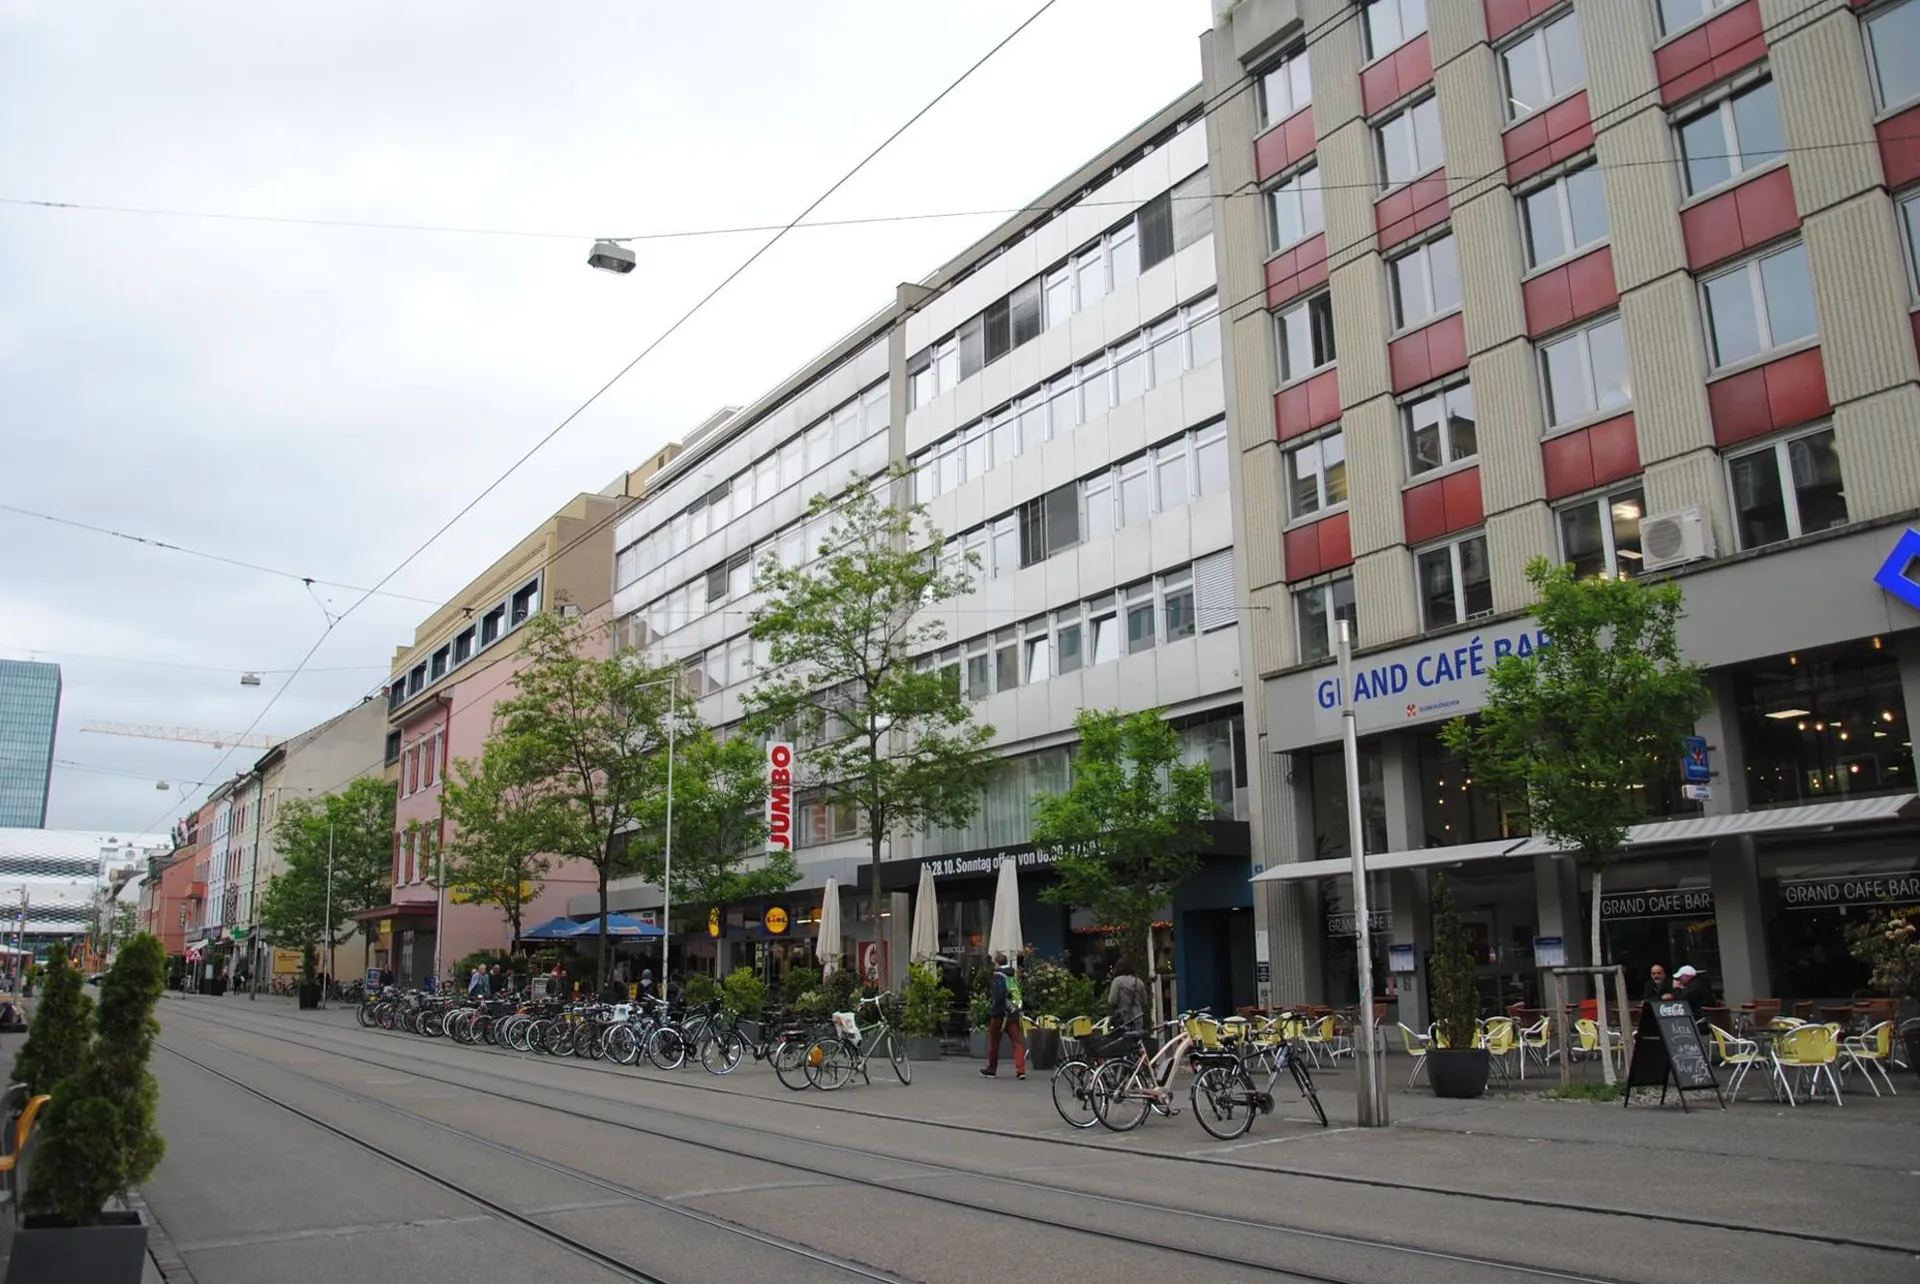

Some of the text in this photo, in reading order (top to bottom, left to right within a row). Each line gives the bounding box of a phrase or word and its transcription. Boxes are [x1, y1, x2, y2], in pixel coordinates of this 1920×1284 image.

[1416, 635, 1486, 687] CAFÉ
[771, 745, 791, 850] JUMBO
[931, 859, 955, 876] 28.10.
[956, 857, 991, 873] Sonntag
[1017, 851, 1035, 866] von
[1785, 878, 1920, 903] GRAND CAFE BAR
[1601, 893, 1711, 915] GRAND CAFE BAR
